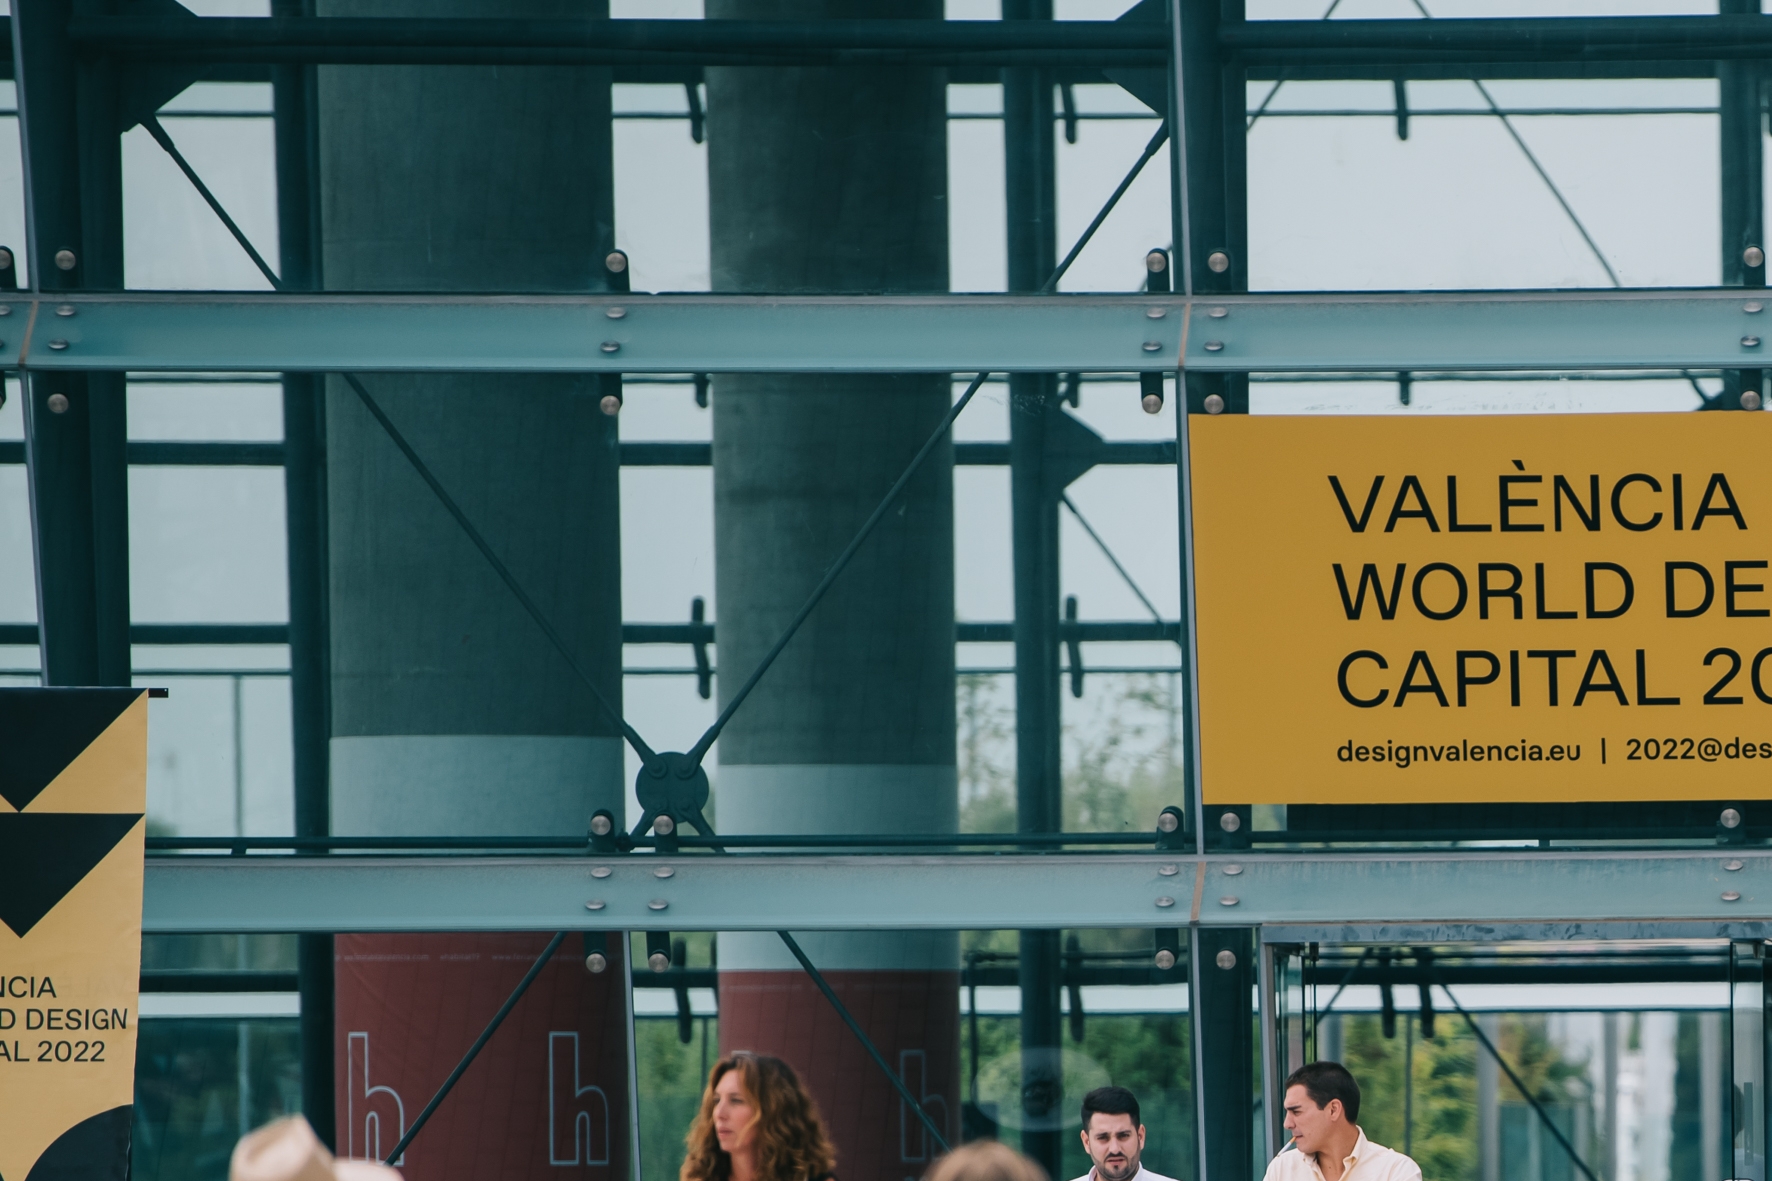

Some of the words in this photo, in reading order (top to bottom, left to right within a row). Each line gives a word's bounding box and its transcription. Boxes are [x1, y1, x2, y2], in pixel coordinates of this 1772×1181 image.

[1327, 459, 1749, 533] VALÈNCIA
[1331, 561, 1635, 621] WORLD
[1337, 648, 1681, 709] CAPITAL
[1336, 738, 1581, 769] designvalencia.eu
[26, 1008, 128, 1031] DESIGN
[37, 1040, 105, 1062] 2022
